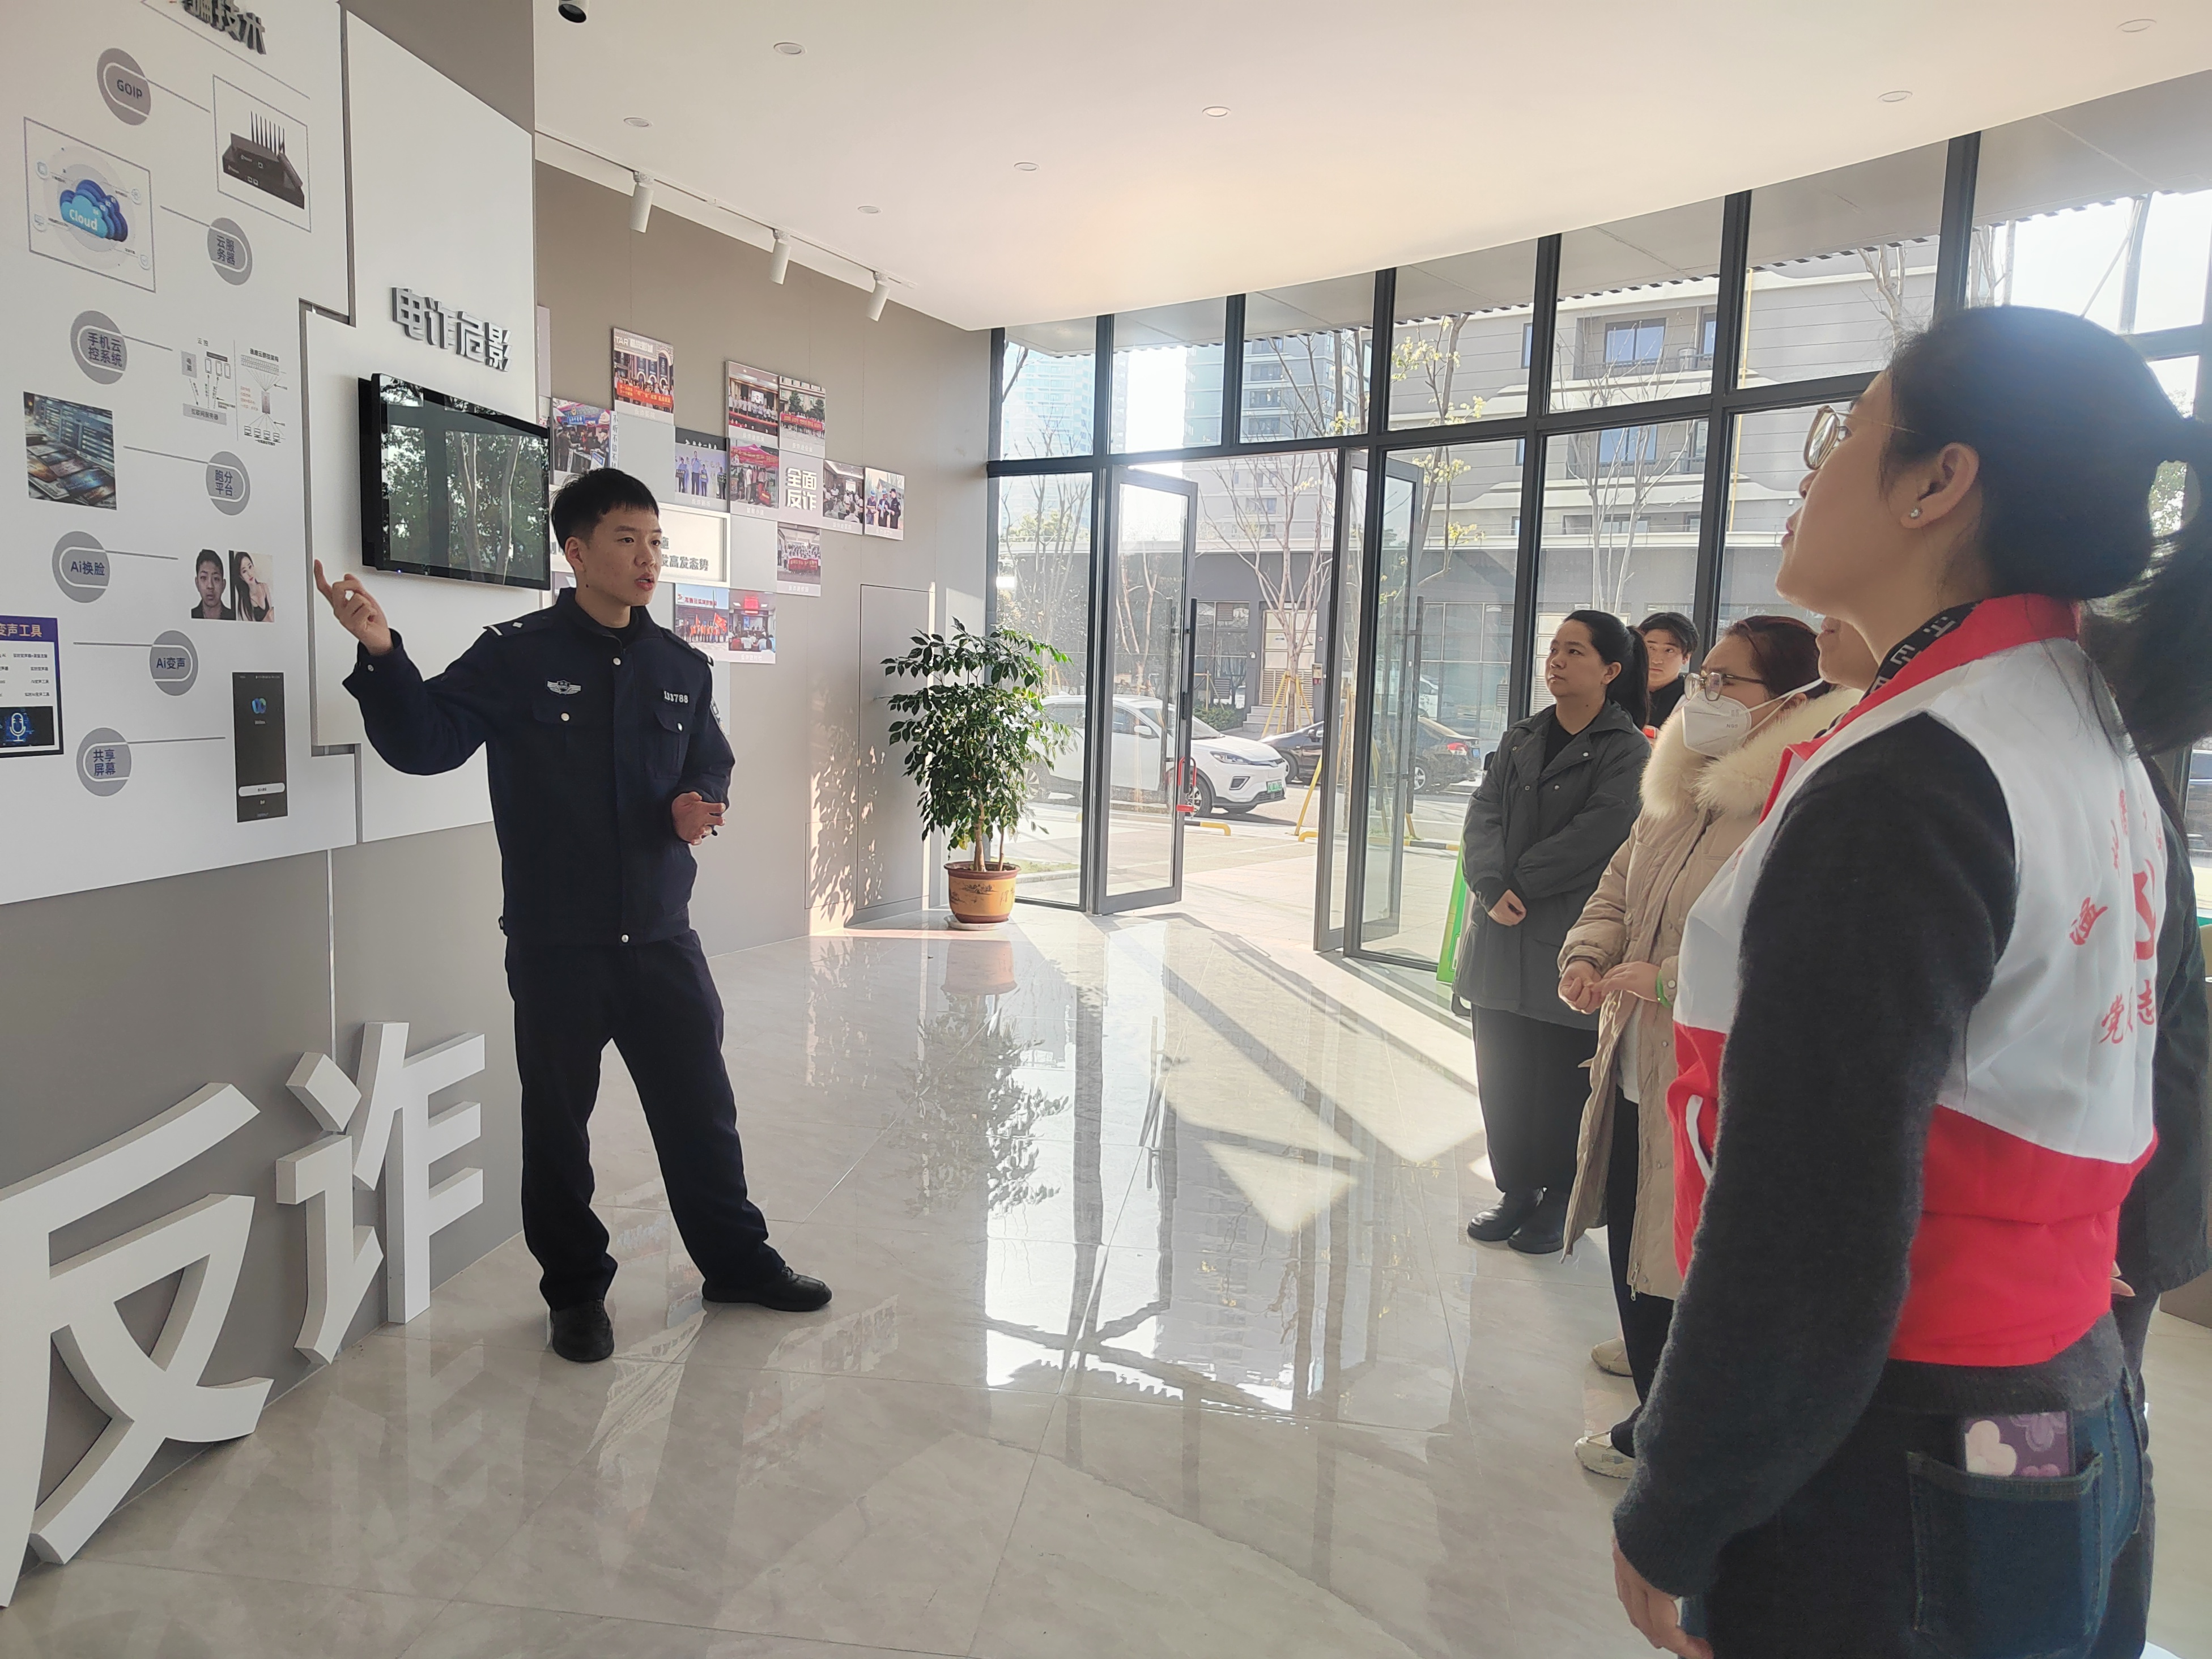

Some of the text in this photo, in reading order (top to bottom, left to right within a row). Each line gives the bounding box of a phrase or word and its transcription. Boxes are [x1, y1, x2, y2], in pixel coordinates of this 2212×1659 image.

[117, 79, 143, 99] GOIP
[69, 209, 98, 231] Cloud
[87, 332, 121, 353] 手机云
[88, 345, 122, 367] 控系统
[215, 470, 233, 486] 跑分
[786, 467, 817, 491] 全面
[215, 482, 233, 496] 平台
[785, 488, 817, 511] 反诈
[70, 561, 105, 577] Ai换脸
[156, 657, 186, 670] Ai变声
[93, 749, 116, 763] 共享
[93, 762, 116, 776] 屏幕
